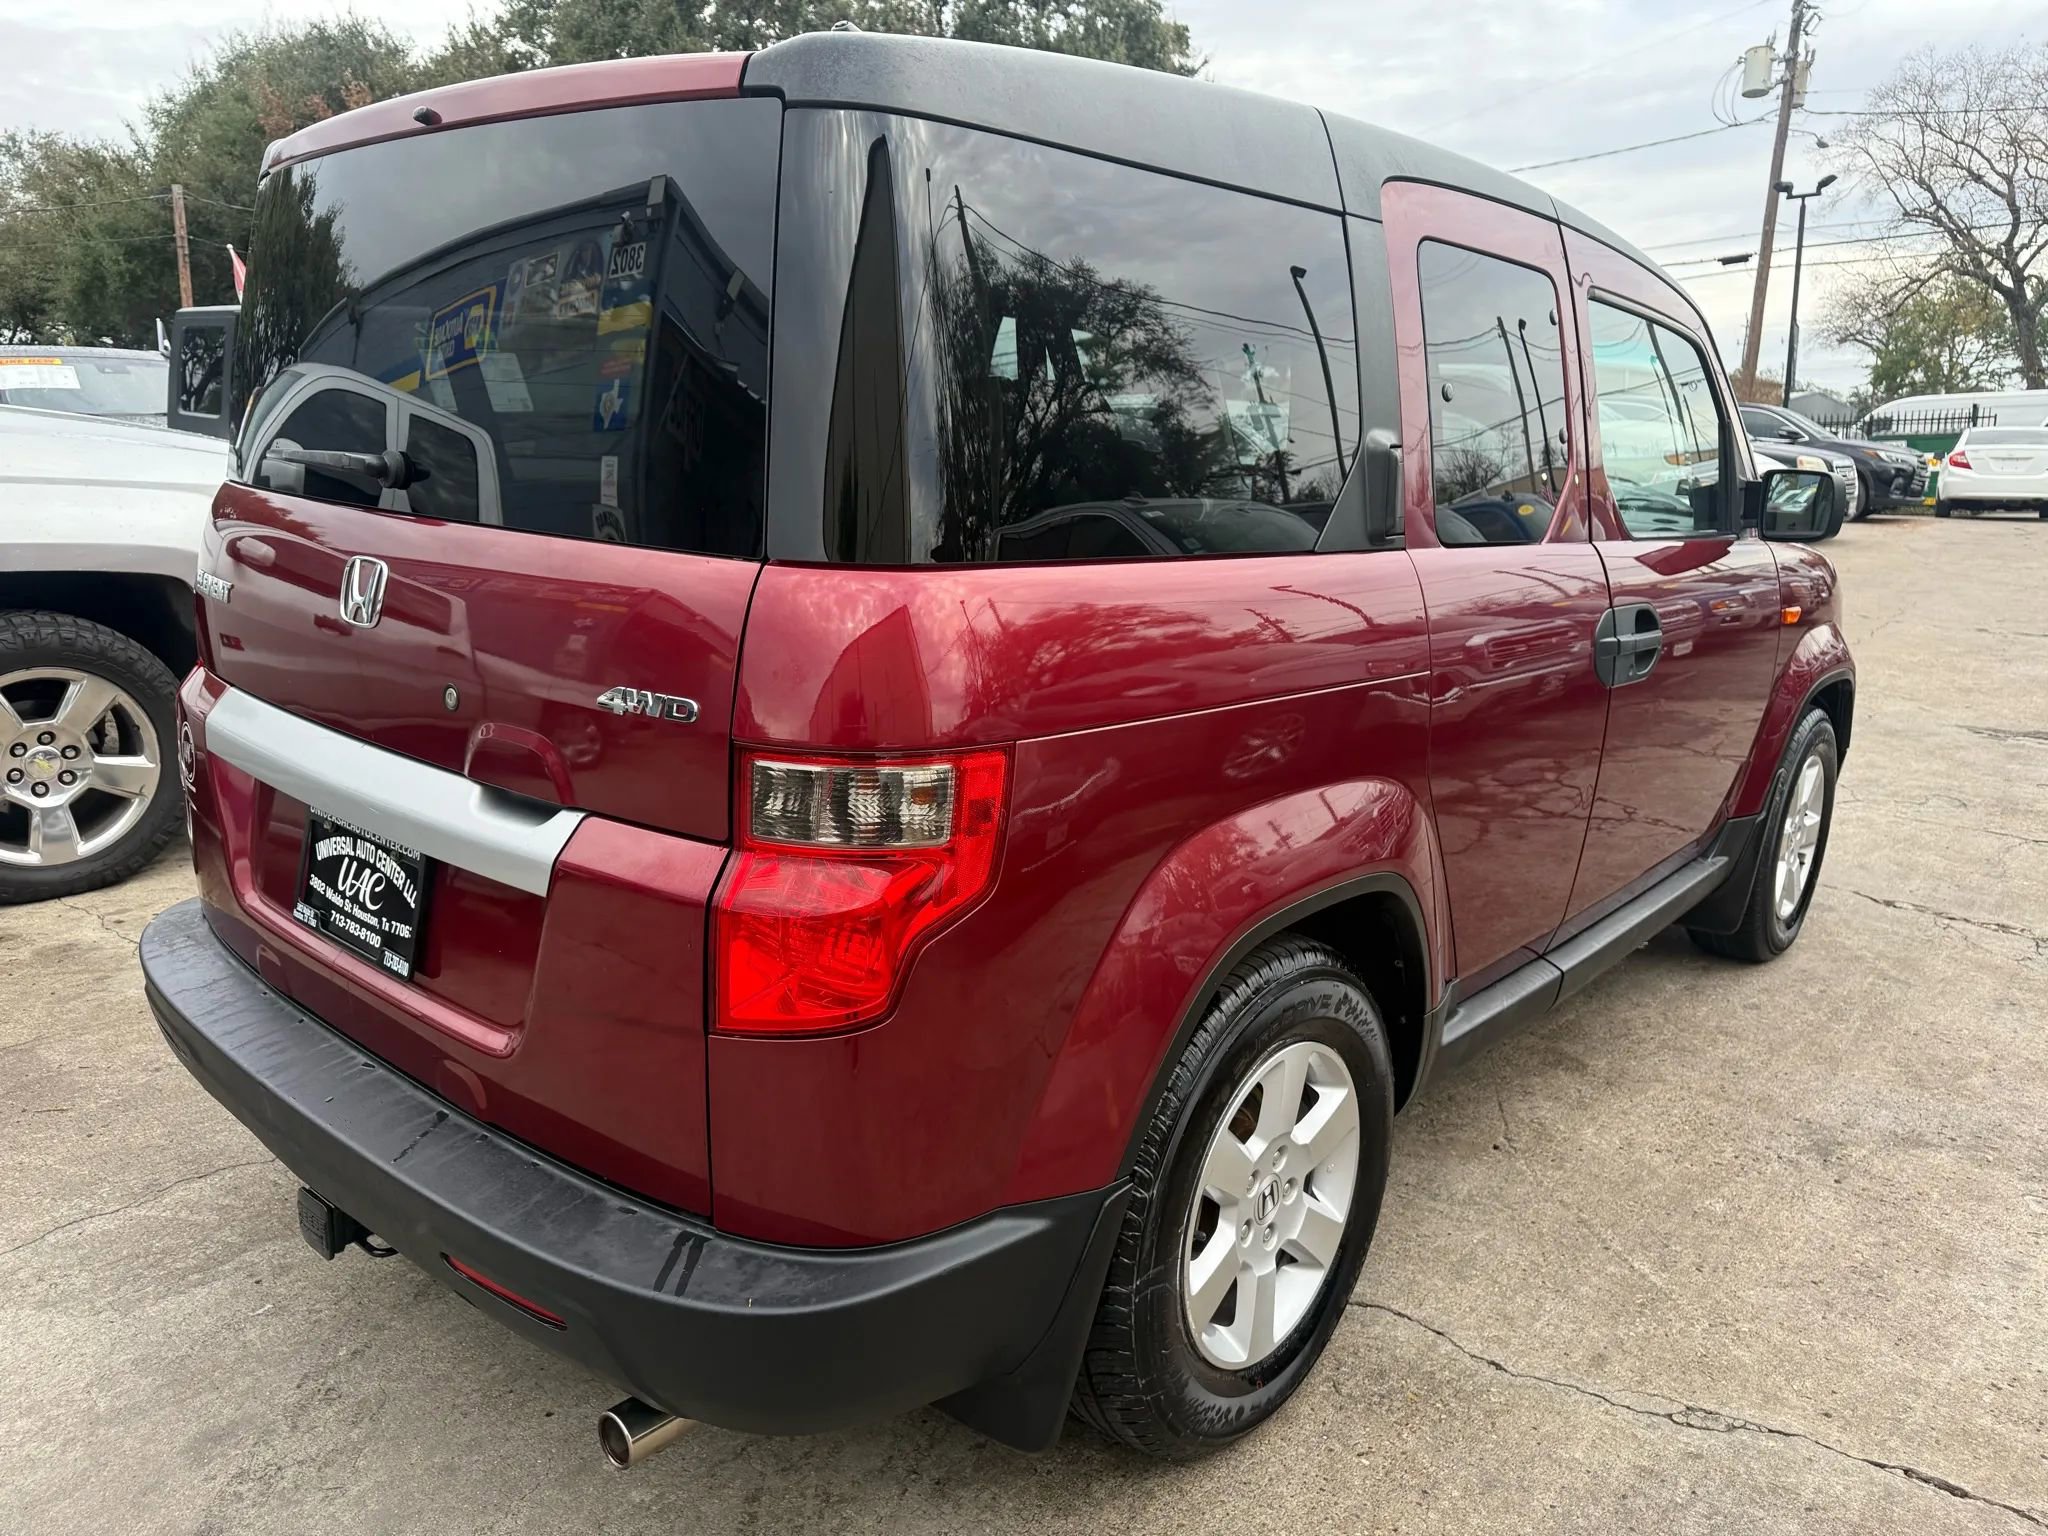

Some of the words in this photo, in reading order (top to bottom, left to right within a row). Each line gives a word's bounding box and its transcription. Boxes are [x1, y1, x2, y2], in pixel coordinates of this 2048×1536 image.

[597, 686, 698, 723] 4WD
[315, 836, 355, 861] UNIVERSAL
[356, 840, 375, 864] AUTO
[376, 849, 406, 889] CENTER
[338, 857, 386, 911] UAC
[309, 873, 325, 895] 3802
[326, 885, 344, 908] Waldo
[343, 899, 352, 913] St
[352, 903, 380, 930] Houston,
[330, 910, 381, 948] 713-783-8100
